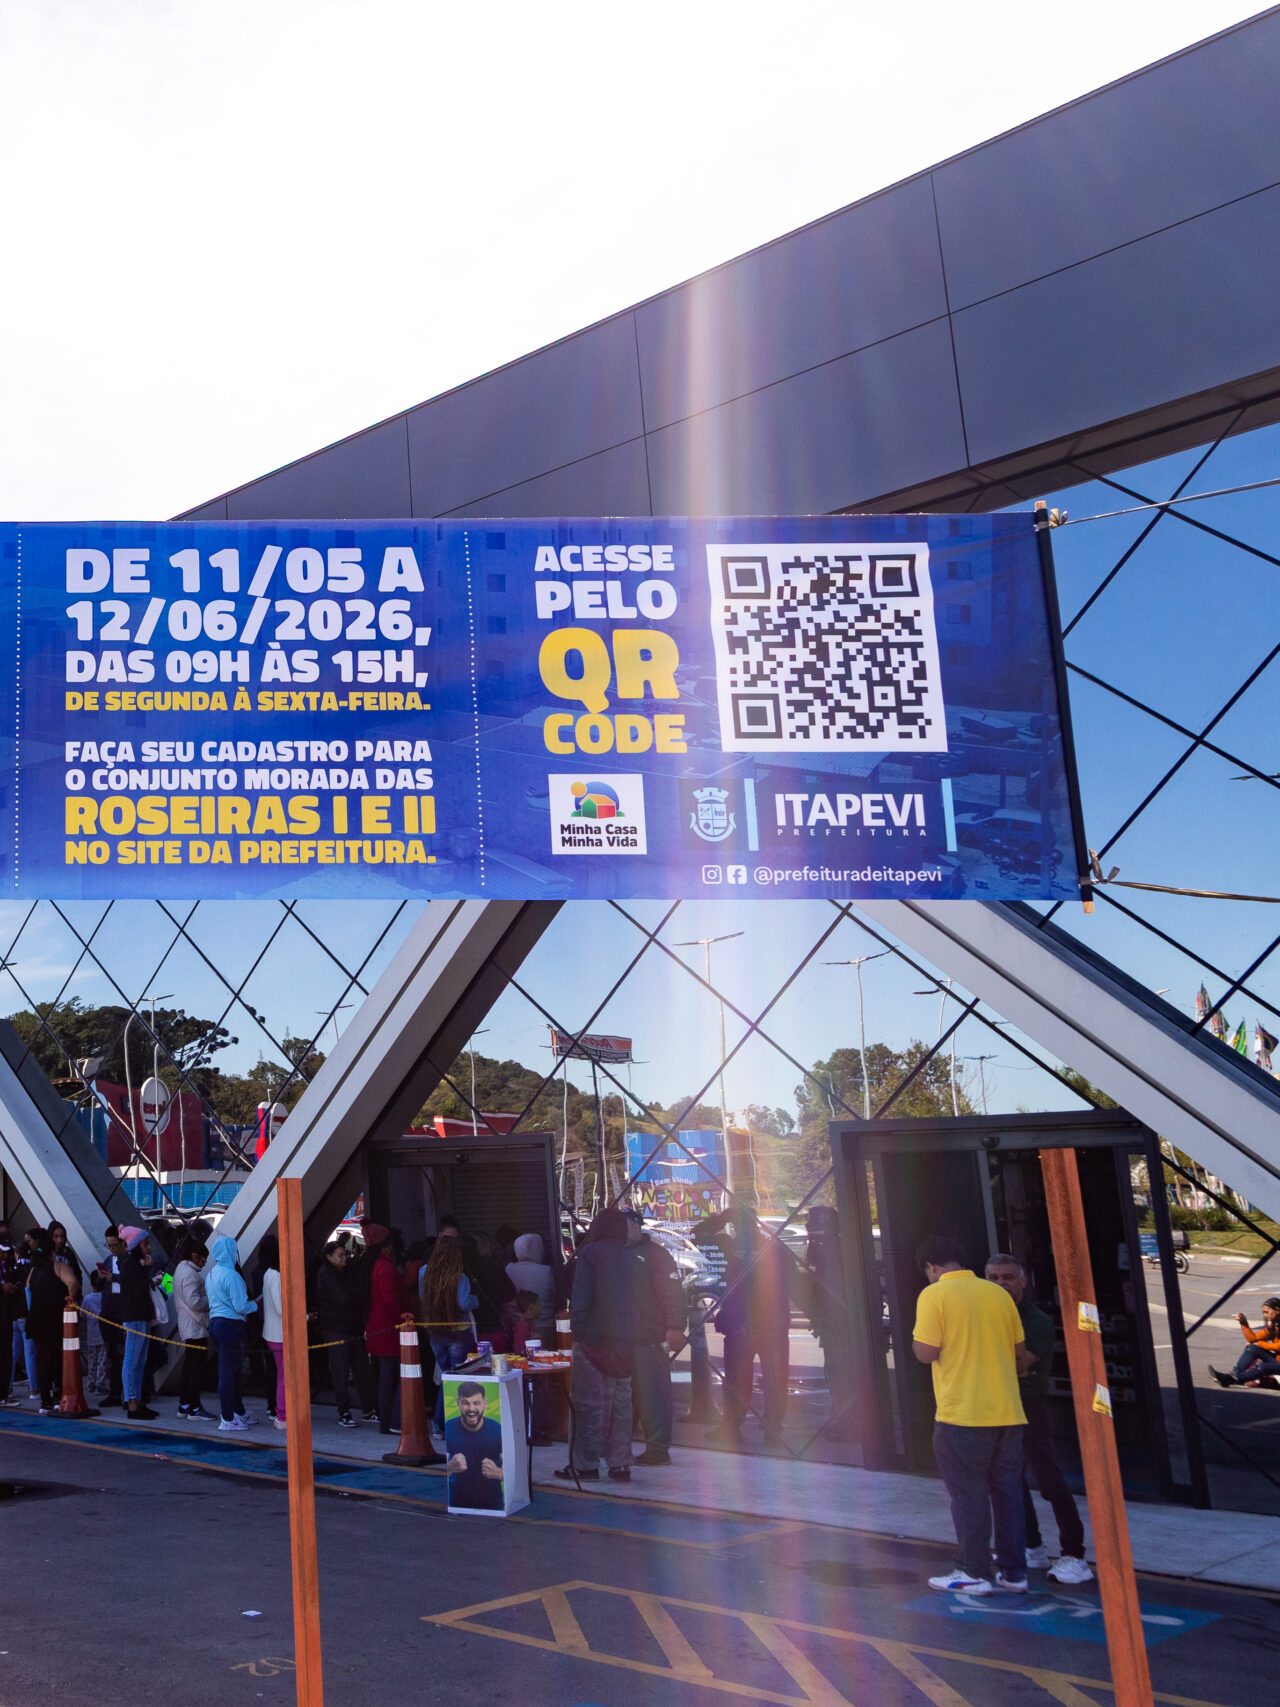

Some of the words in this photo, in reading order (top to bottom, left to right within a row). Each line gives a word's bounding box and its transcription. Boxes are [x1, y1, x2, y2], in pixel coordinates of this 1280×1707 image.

[65, 548, 150, 593] DE
[169, 545, 365, 598] 11/05
[378, 546, 425, 593] A
[534, 544, 675, 572] ACESSE
[534, 579, 678, 620] PELO
[65, 597, 432, 646] 12/06/2026,
[65, 650, 156, 683] DAS
[165, 650, 250, 683] 09H
[260, 642, 320, 683] ÀS
[331, 649, 429, 688] 15H,
[538, 626, 680, 715] QR
[65, 691, 99, 711] DE
[105, 691, 227, 711] SEGUNDA
[233, 686, 251, 711] À
[257, 691, 431, 711] SEXTA-FEIRA.
[543, 713, 688, 755] CODE
[65, 741, 135, 769] FAÇA
[141, 741, 195, 762] SEU
[201, 740, 349, 762] CADASTRO
[355, 740, 432, 762] PARA
[65, 769, 86, 791] O
[92, 768, 238, 791] CONJUNTO
[244, 768, 369, 790] MORADA
[375, 768, 434, 790] DAS
[65, 795, 319, 835] ROSEIRAS
[333, 795, 348, 835] I
[360, 795, 391, 835] E
[403, 795, 436, 835] II
[774, 793, 926, 827] ITAPEVI
[560, 823, 602, 835] Minha
[605, 823, 638, 835] Casa
[561, 836, 603, 847] Minha
[606, 836, 638, 847] Vida
[777, 828, 927, 837] PREFEITURA
[65, 841, 110, 864] NO
[117, 841, 182, 864] SITE
[189, 841, 233, 864] DA
[239, 840, 437, 864] PREFEITURA.
[753, 865, 942, 886] @prefeituradeitapevi
